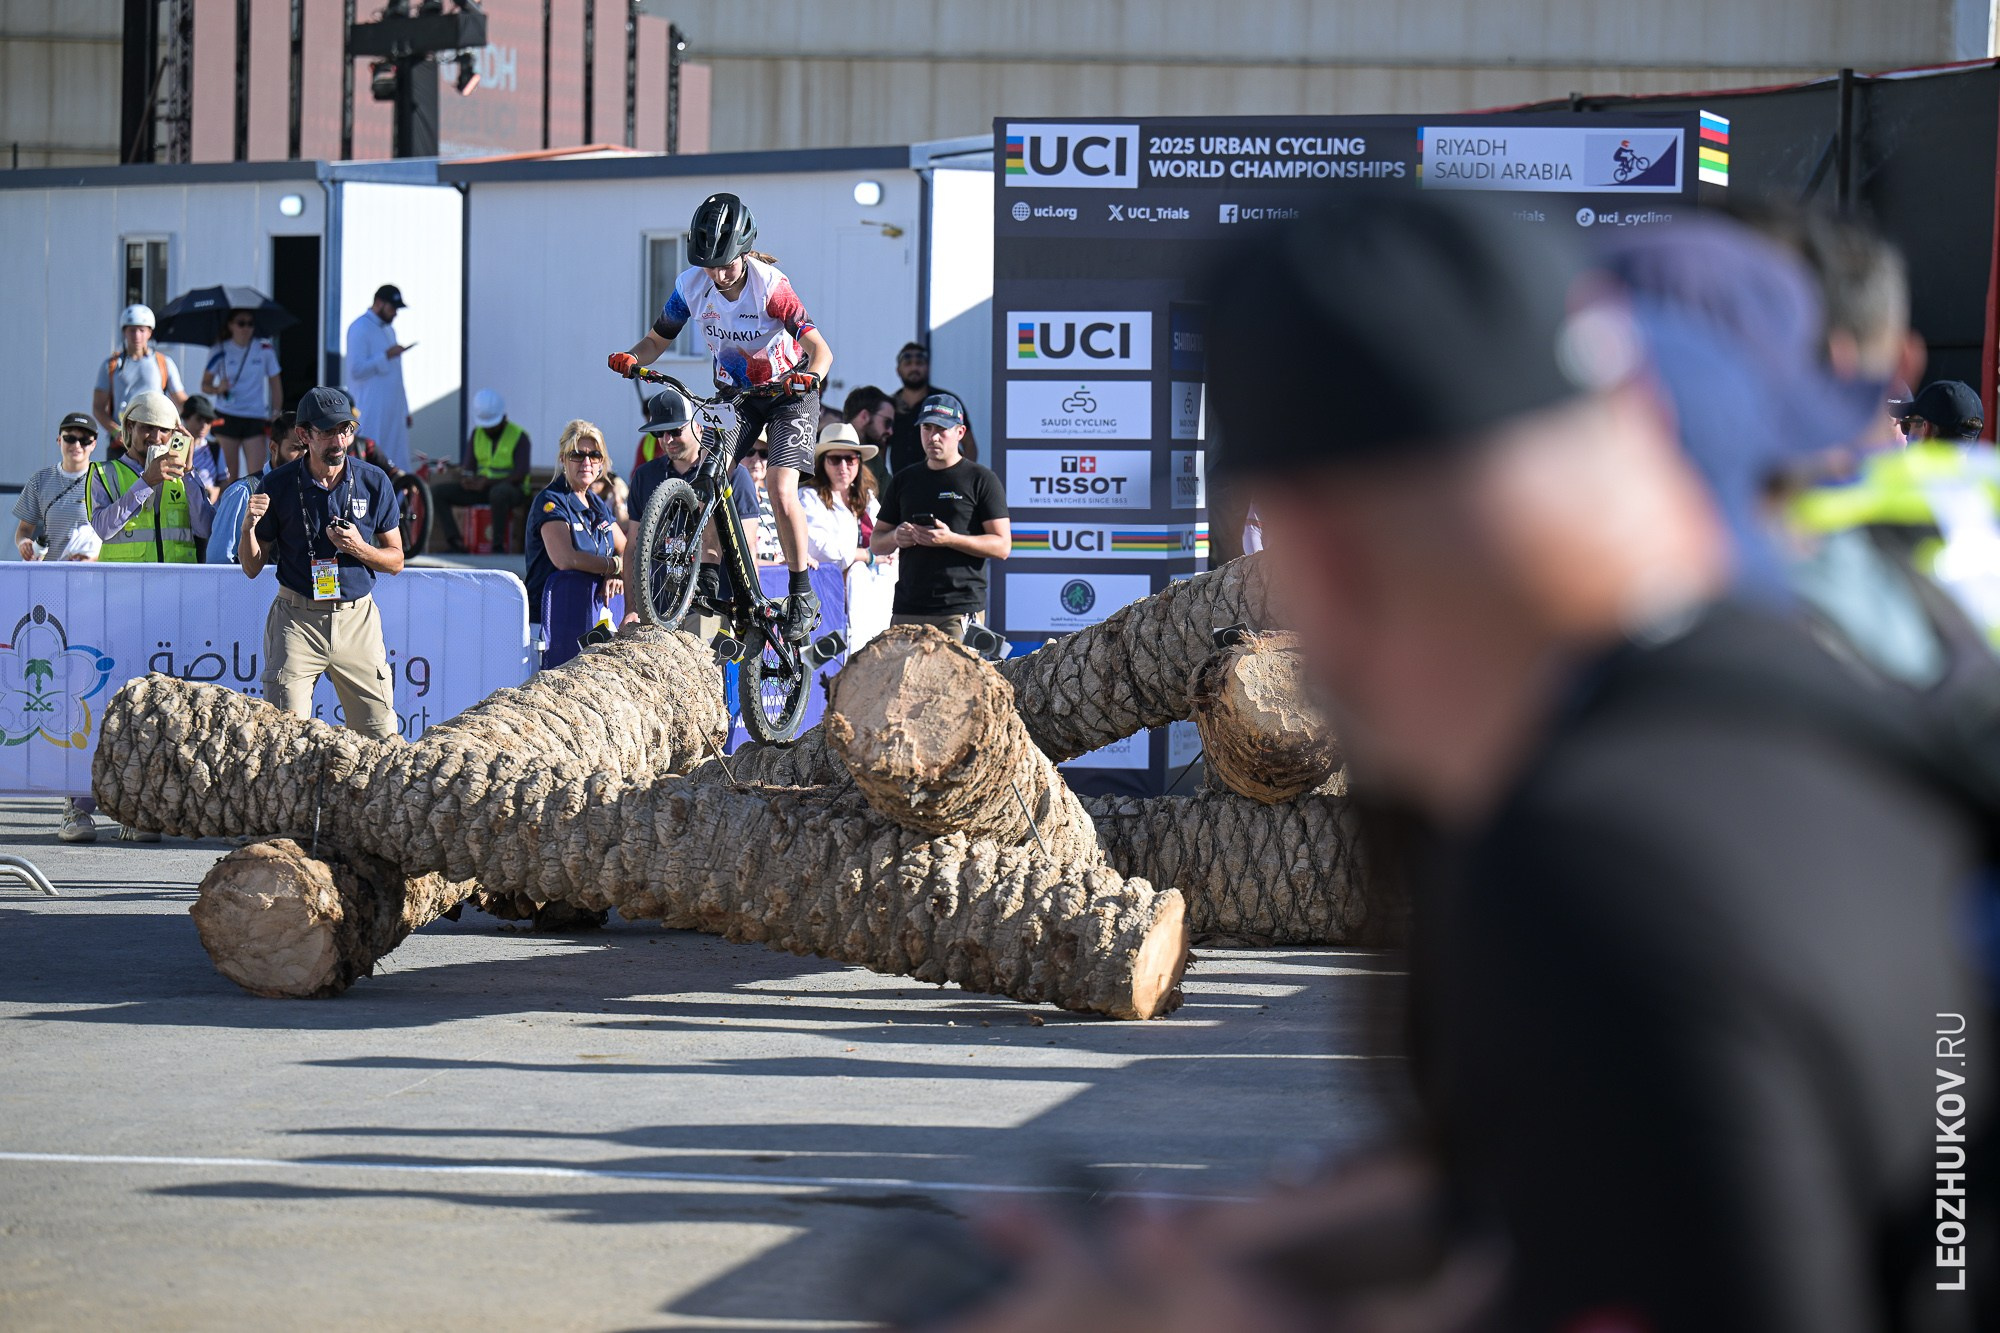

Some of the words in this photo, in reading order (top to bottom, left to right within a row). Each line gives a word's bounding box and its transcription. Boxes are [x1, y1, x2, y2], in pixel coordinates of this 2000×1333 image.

[1149, 137, 1195, 155] 2025
[1200, 137, 1269, 155] URBAN
[1275, 138, 1366, 156] CYCLING
[1435, 138, 1507, 156] RIYADH
[1029, 136, 1127, 176] UCI
[1149, 160, 1225, 178] WORLD
[1229, 160, 1406, 179] CHAMPIONSHIPS
[1434, 162, 1495, 180] SAUDI
[1501, 163, 1573, 181] ARABIA
[1033, 206, 1078, 220] uci.org
[1127, 207, 1190, 222] UCI_Trials
[1241, 208, 1264, 220] UCI
[1266, 208, 1299, 220] Trials
[1599, 211, 1673, 226] uci_cycling
[1039, 322, 1131, 359] UCI
[1030, 477, 1127, 494] TISSOT
[1052, 530, 1103, 551] UCI
